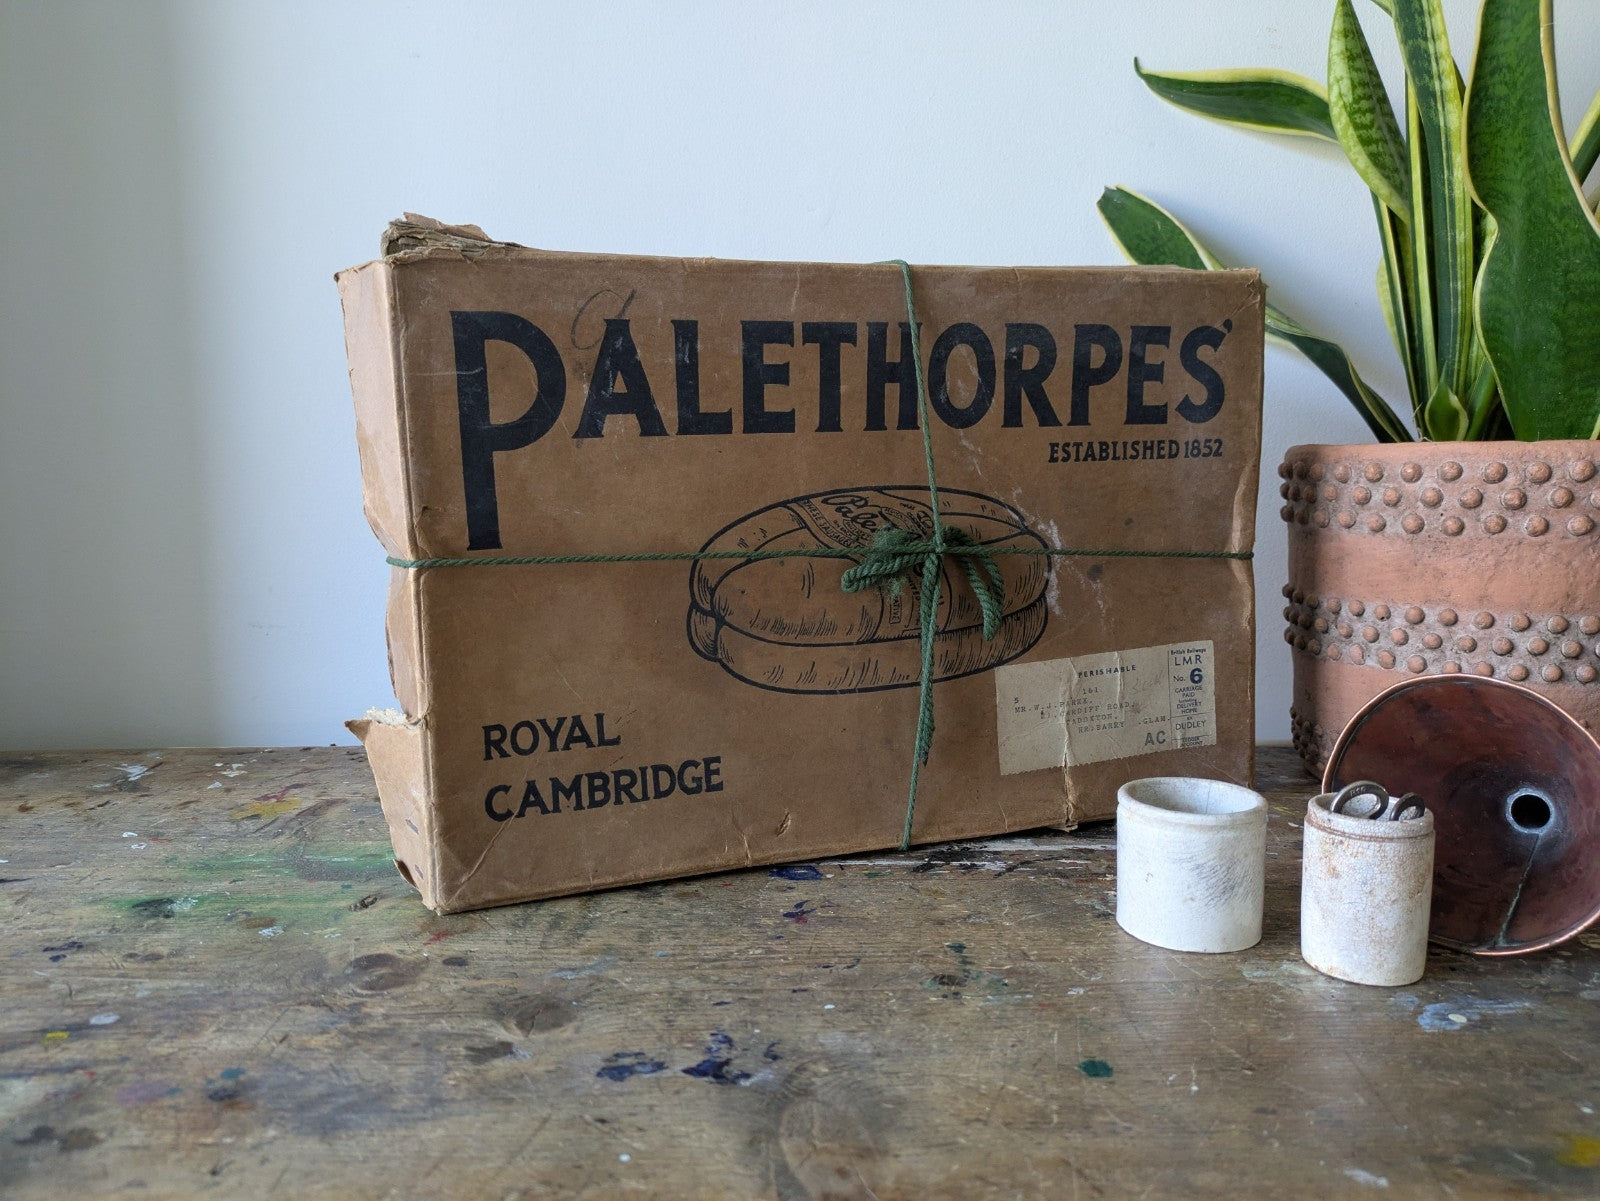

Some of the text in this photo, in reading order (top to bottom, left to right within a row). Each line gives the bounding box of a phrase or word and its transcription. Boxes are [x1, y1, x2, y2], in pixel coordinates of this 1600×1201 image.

[1048, 438, 1223, 464] ESTABLISHED 1852
[1174, 654, 1203, 667] LMR
[1078, 664, 1137, 679] PERISHABLE
[1190, 667, 1203, 685] 6
[1175, 719, 1207, 731] DUDLEY
[482, 712, 622, 761] ROYAL
[1144, 730, 1166, 746] AC
[484, 755, 724, 822] CAMBRIDGE
